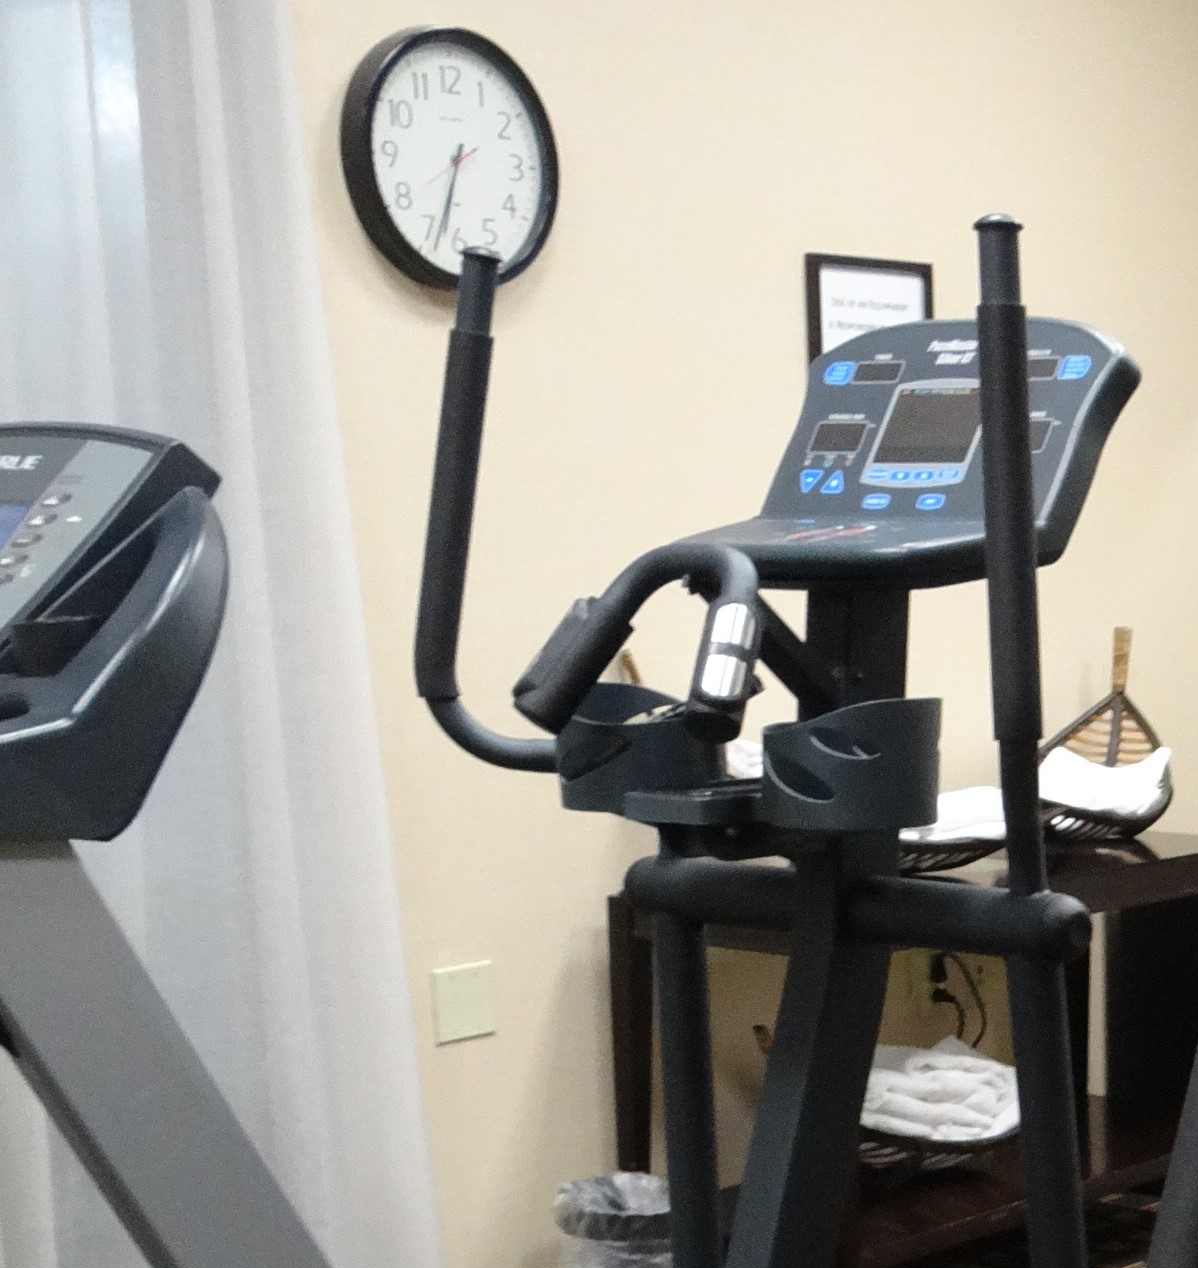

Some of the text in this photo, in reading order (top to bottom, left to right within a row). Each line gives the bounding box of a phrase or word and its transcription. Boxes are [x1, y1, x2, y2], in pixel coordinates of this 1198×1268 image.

[411, 72, 429, 101] 11
[438, 65, 462, 95] 12
[476, 81, 485, 108] 1
[388, 98, 414, 129] 10
[496, 111, 512, 140] 2
[380, 140, 399, 167] 9
[508, 154, 524, 181] 3
[394, 181, 413, 210] 8
[501, 194, 518, 219] 4
[421, 214, 437, 242] 7
[450, 227, 468, 253] 6
[481, 218, 498, 246] 5
